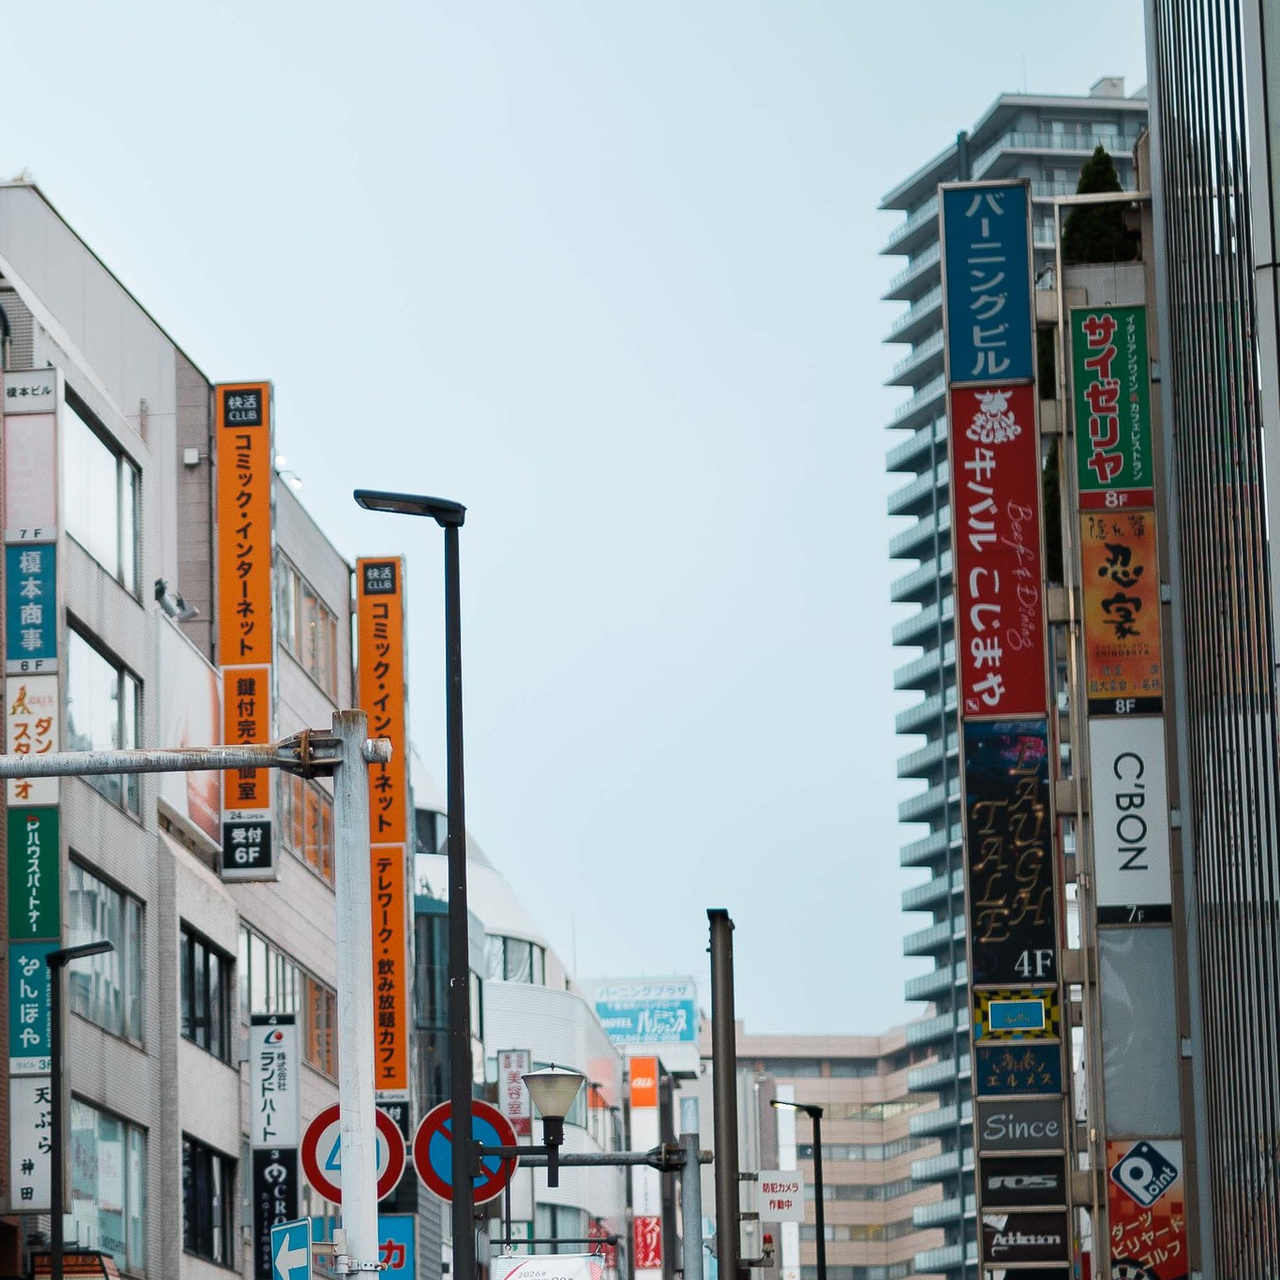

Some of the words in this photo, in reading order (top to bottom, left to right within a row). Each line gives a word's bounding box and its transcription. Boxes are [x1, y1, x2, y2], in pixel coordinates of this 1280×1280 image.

[965, 193, 1011, 377] バーニングビル
[228, 394, 257, 410] 快活
[1082, 312, 1125, 484] サイゼリヤ
[228, 410, 257, 421] CLUB
[1104, 490, 1128, 508] 8F
[235, 433, 254, 657] コミック・インターネット
[367, 567, 393, 580] 快活
[367, 579, 393, 590] CLUB
[19, 550, 44, 651] 榎本商事
[1097, 541, 1145, 640] 忍家
[970, 566, 1006, 707] こじまや
[1115, 698, 1137, 714] 8F
[1113, 751, 1149, 872] C'BON
[231, 827, 263, 844] 受付
[234, 846, 260, 864] 6F
[972, 800, 1011, 944] TALE
[1126, 904, 1145, 925] 7F
[375, 856, 397, 1079] テレワーク・飲み放題カフェ
[1013, 949, 1054, 978] 4F
[18, 955, 41, 1048] なんぼや
[632, 1076, 657, 1088] au
[986, 1073, 1052, 1088] エルメス
[260, 1051, 277, 1142] ランドハート
[33, 1086, 52, 1155] 天ぷら
[983, 1113, 1060, 1141] Since
[19, 1158, 35, 1202] 神田
[761, 1181, 800, 1194] 防犯カメラ
[768, 1199, 793, 1211] 作動中
[1110, 1210, 1154, 1240] ダーツ
[1112, 1216, 1185, 1260] ビリヤード
[1138, 1240, 1183, 1272] ゴルフ
